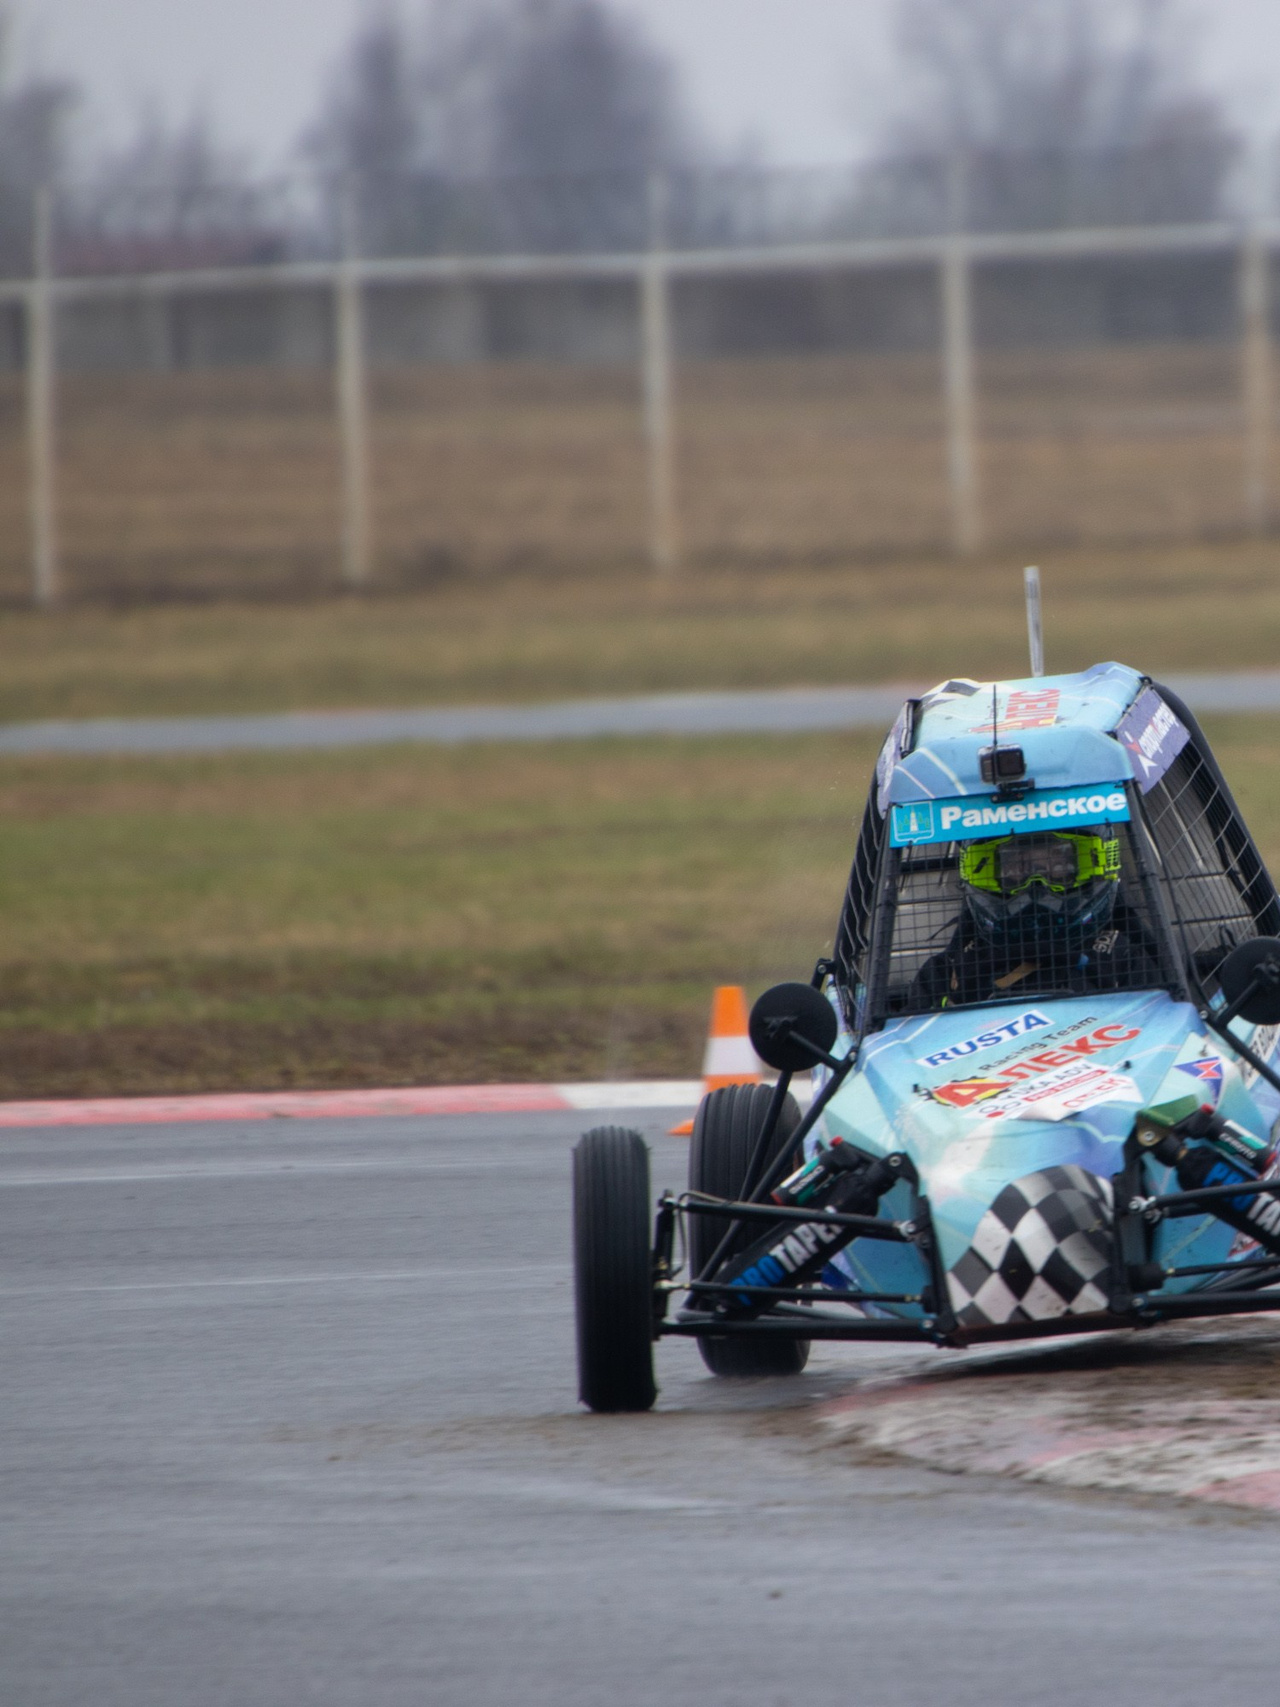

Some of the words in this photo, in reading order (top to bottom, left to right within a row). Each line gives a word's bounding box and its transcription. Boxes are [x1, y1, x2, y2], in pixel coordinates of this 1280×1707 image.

[941, 793, 1128, 830] Раменское
[925, 1013, 1048, 1068] RUSTA
[978, 1037, 1047, 1072] Racing
[1045, 1016, 1098, 1041] Team
